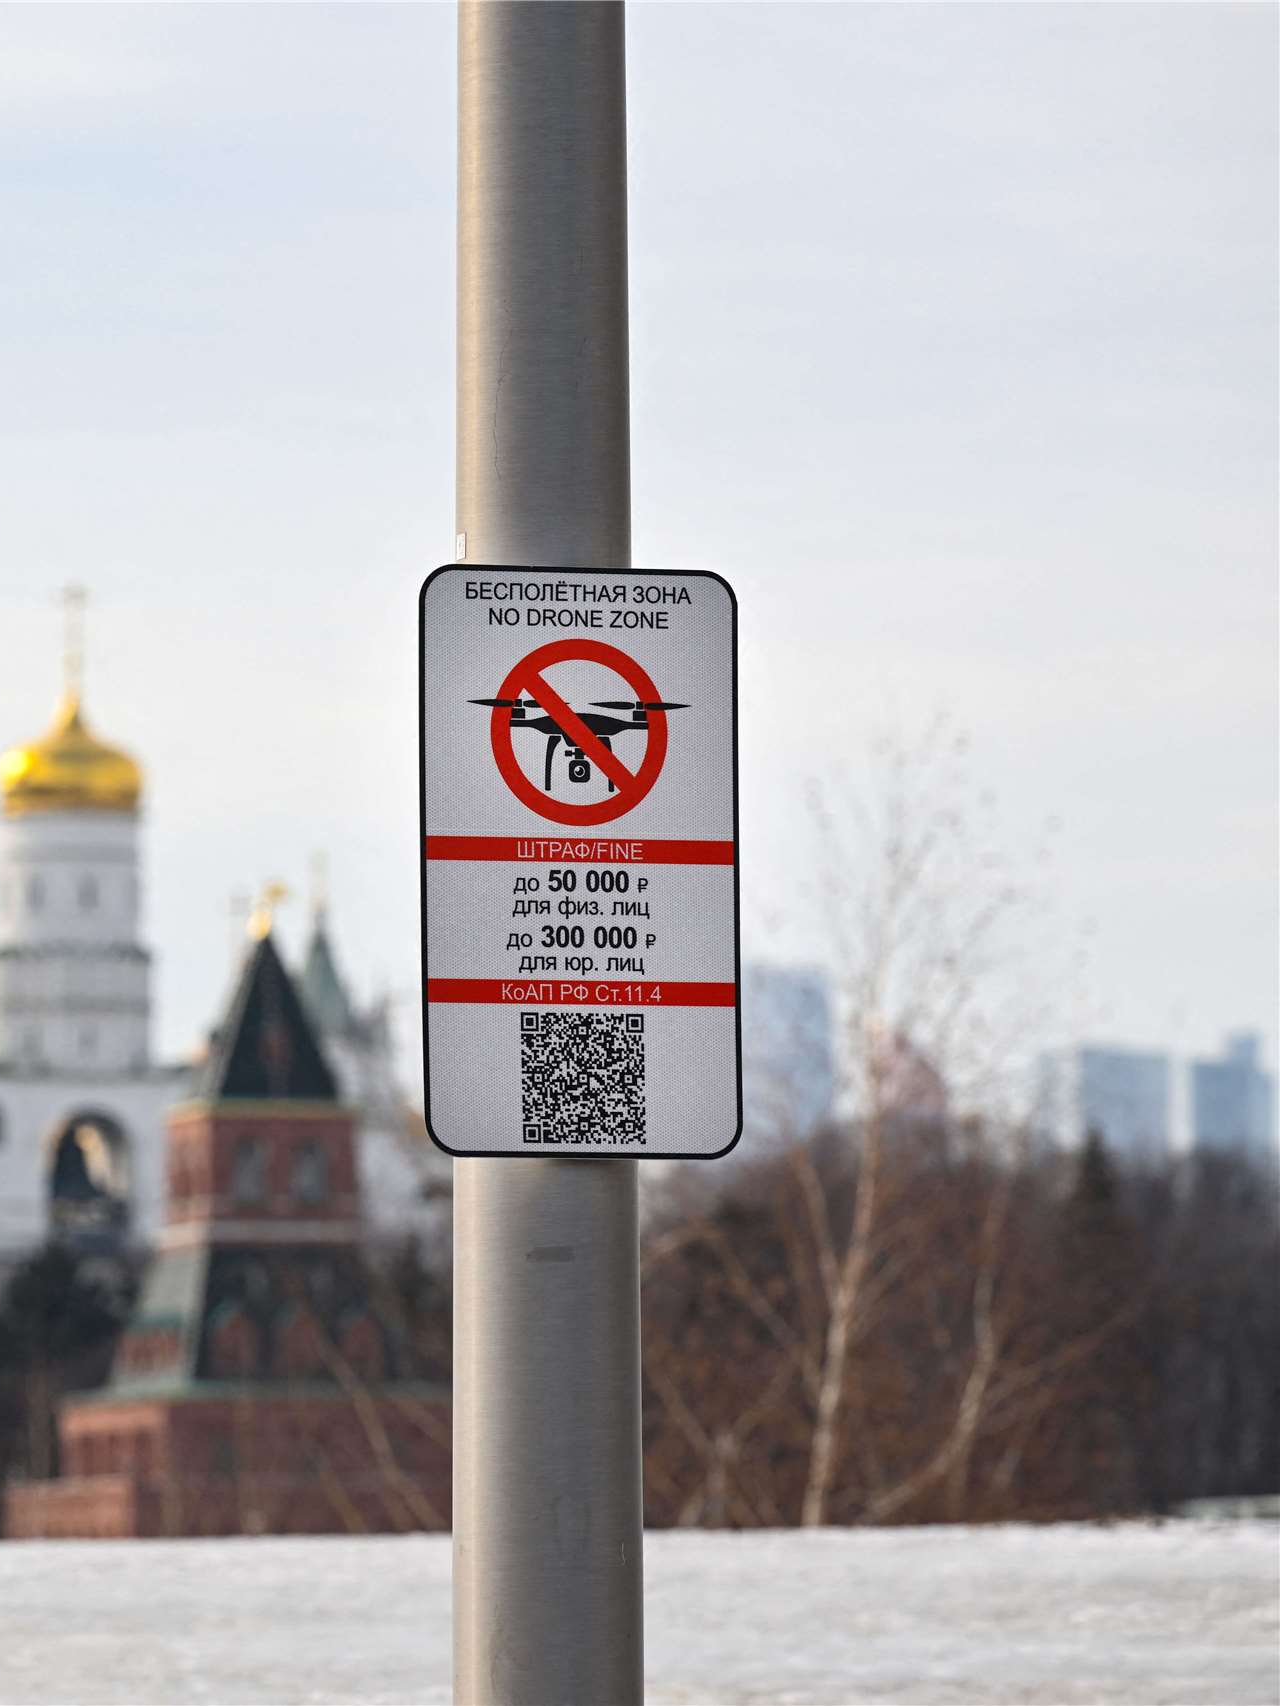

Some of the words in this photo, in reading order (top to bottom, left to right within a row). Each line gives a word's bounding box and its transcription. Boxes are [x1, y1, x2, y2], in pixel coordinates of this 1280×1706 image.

[465, 580, 626, 603] БЕСПОЛЁТНАЯ
[632, 585, 692, 604] ЗОНА
[488, 607, 520, 626] NO
[527, 608, 603, 627] DRONE
[609, 610, 669, 629] ZONE
[517, 841, 644, 860] ШТРАФ/FINE
[513, 877, 540, 894] до
[547, 869, 577, 892] 50
[585, 869, 630, 893] 000
[512, 899, 551, 917] для
[558, 896, 604, 919] физ.
[611, 900, 650, 919] лиц
[506, 932, 533, 950] до
[541, 925, 585, 948] 300
[593, 925, 638, 949] 000
[518, 956, 557, 973] для
[564, 956, 599, 975] юр.
[605, 956, 644, 975] лиц
[501, 983, 553, 1001] КоАП
[560, 983, 589, 1001] РФ
[595, 984, 662, 1002] Ст.11.4
